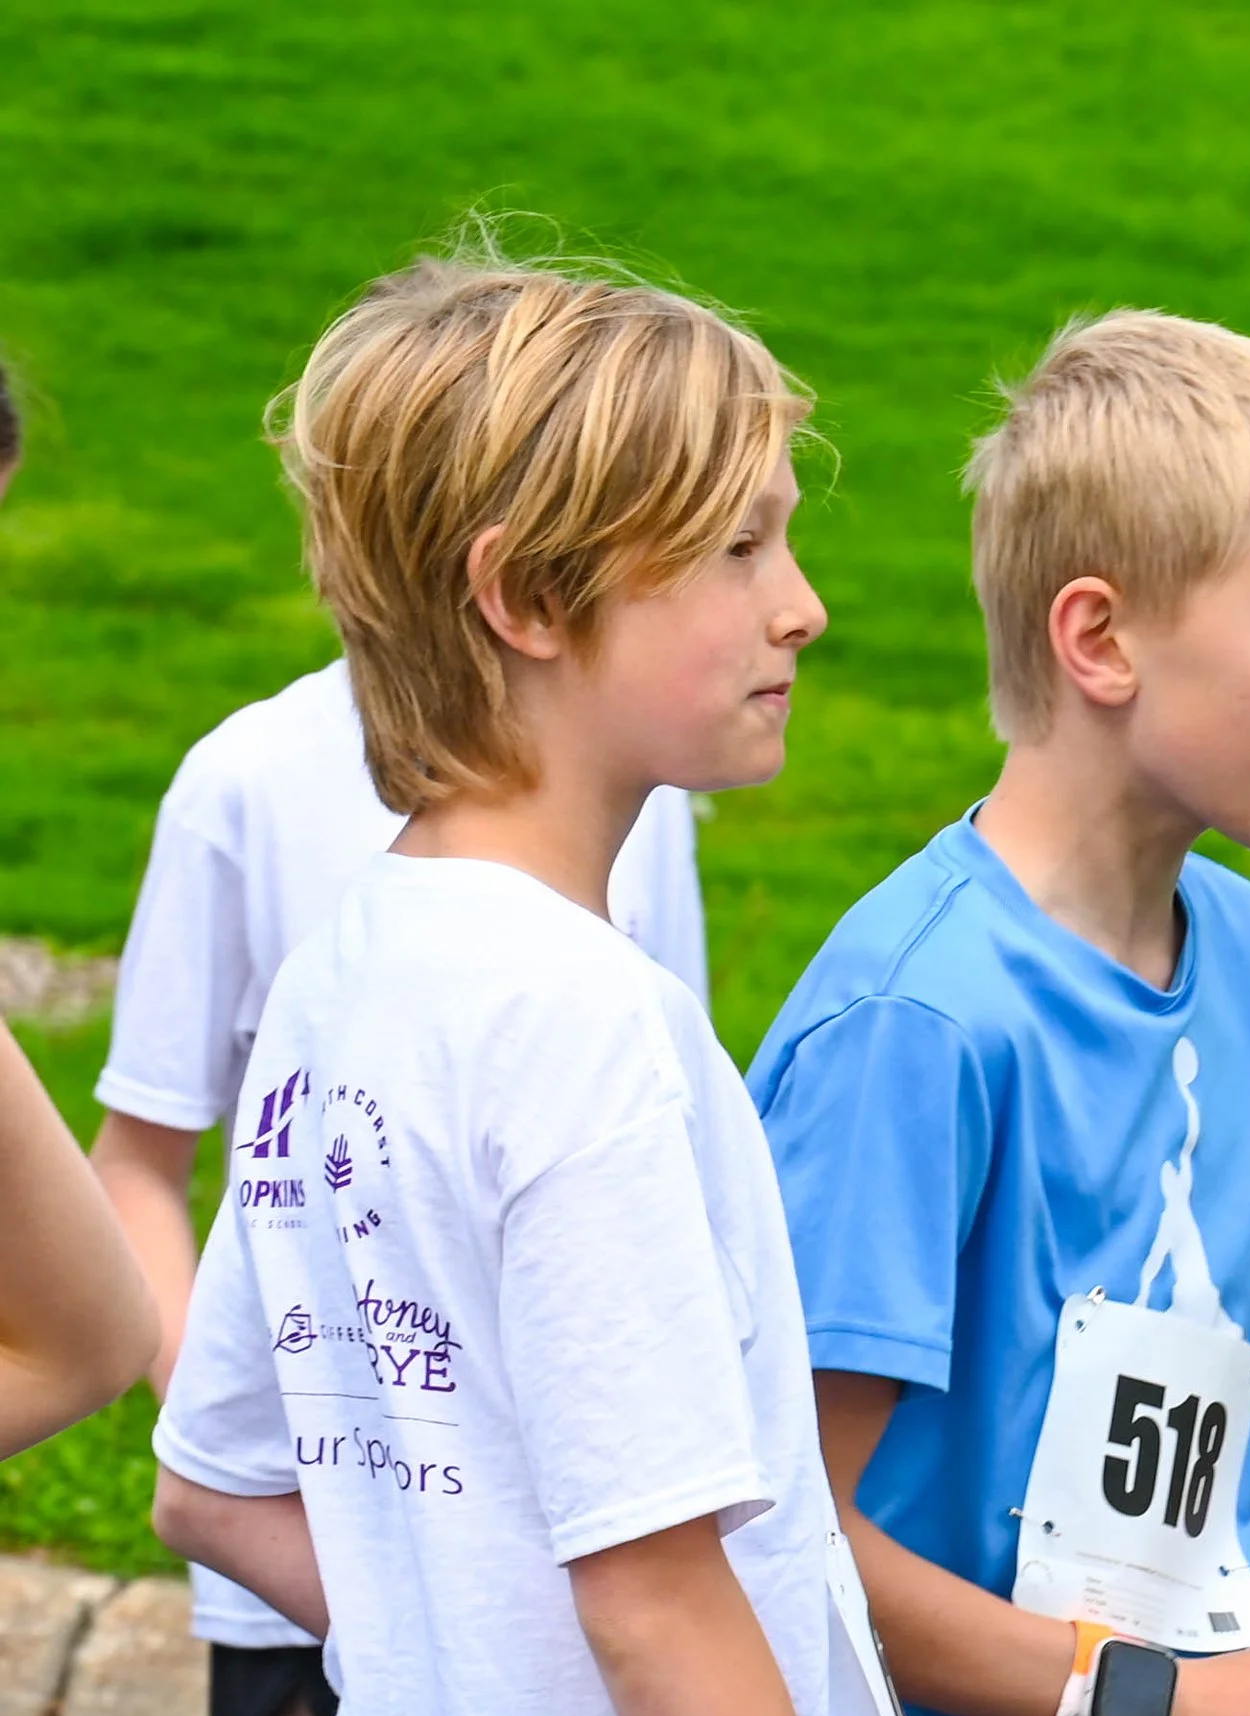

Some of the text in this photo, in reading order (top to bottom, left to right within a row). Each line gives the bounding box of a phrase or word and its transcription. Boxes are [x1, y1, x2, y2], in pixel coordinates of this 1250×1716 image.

[337, 1208, 381, 1243] ING
[385, 1331, 417, 1344] and
[1103, 1374, 1227, 1538] 518
